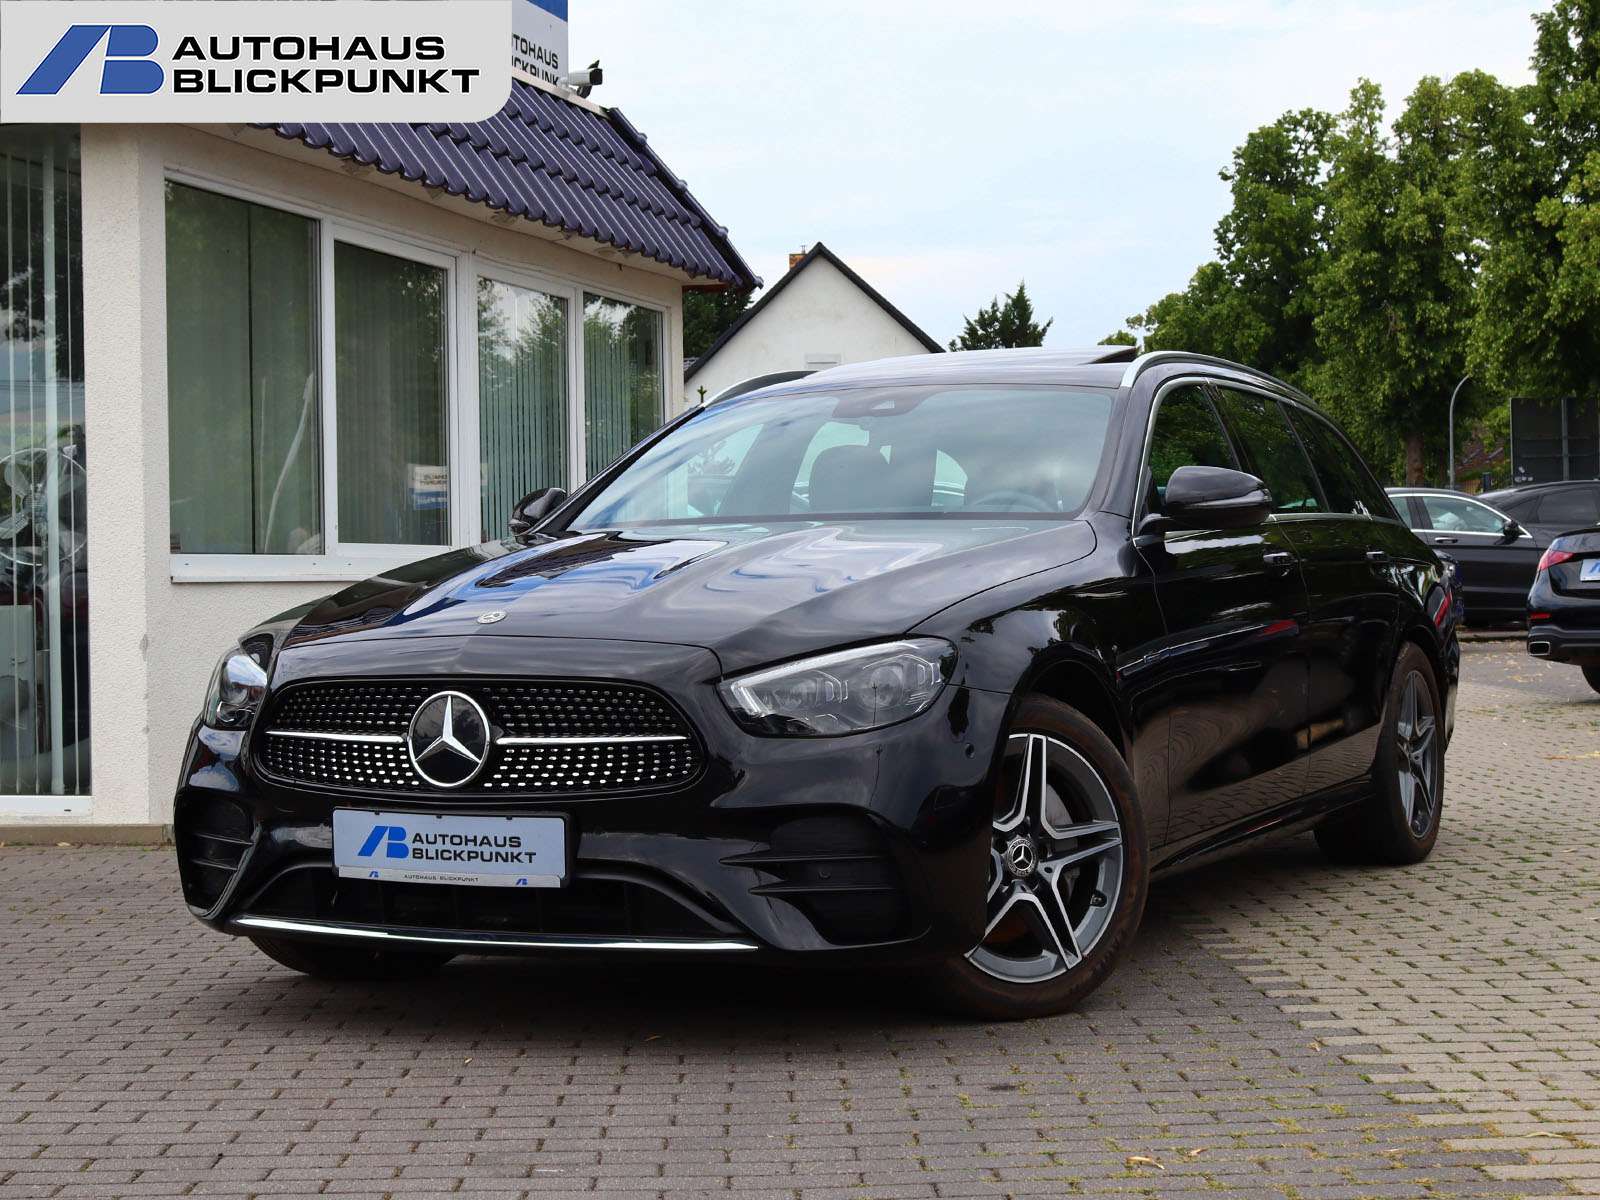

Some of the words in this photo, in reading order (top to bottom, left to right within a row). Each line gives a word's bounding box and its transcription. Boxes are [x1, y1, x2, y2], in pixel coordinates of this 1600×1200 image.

[511, 33, 559, 70] TOHAUS
[412, 832, 522, 848] AUTOHAUS
[412, 848, 536, 864] BLICKPUNKT
[404, 873, 437, 881] AUTOHAUS
[439, 875, 479, 883] BLICKPUNKT
